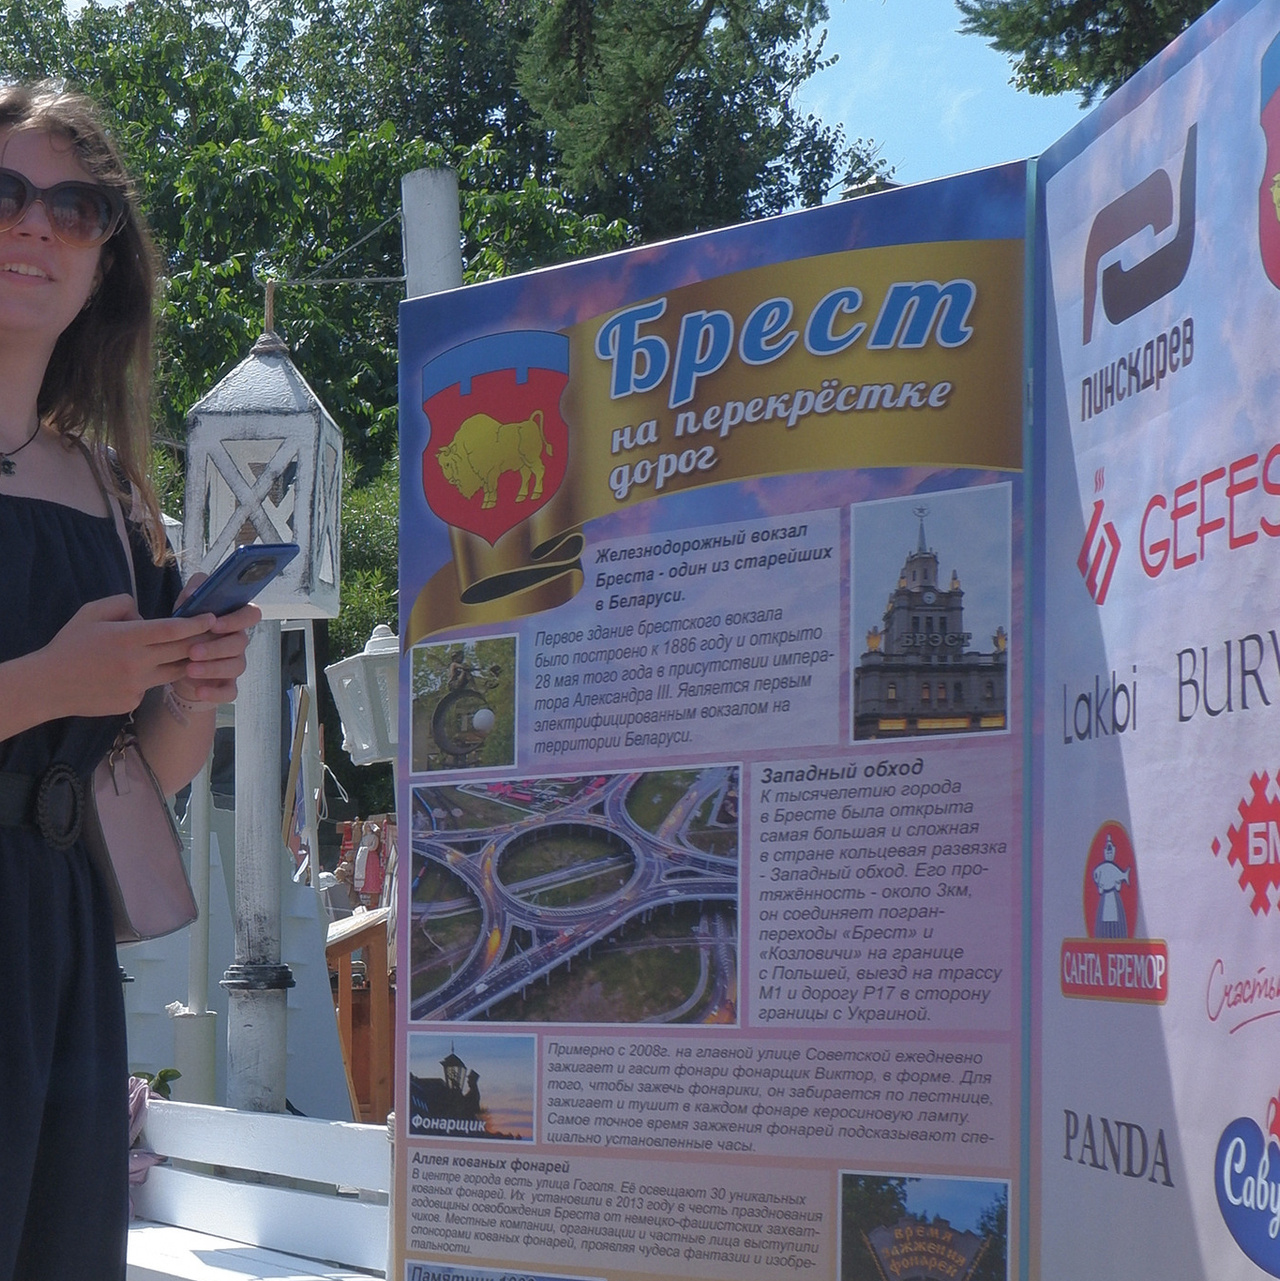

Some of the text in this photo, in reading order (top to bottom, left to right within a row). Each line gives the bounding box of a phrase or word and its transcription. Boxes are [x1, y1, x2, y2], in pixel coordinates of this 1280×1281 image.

[594, 277, 977, 409] Брест
[611, 376, 953, 455] на перекрёстке
[608, 442, 719, 500] дорог
[594, 524, 808, 565] Железнодорожный вокзал
[595, 569, 655, 591] Бреста
[668, 561, 708, 579] один
[711, 559, 730, 573] из
[733, 546, 834, 571] старейших
[595, 599, 605, 612] в
[534, 607, 783, 649] Первое здание брестского вокзала
[900, 632, 972, 648] БРЭСТ
[534, 626, 823, 669] было построено к 1886 году и открыто
[534, 673, 552, 690] 28
[553, 673, 580, 688] мая
[582, 670, 619, 685] того
[620, 663, 654, 682] года
[656, 665, 666, 678] в
[668, 655, 770, 680] присутствии
[533, 696, 570, 714] тора
[572, 686, 654, 708] Александра
[676, 679, 751, 699] Является
[753, 674, 813, 694] первым
[1063, 664, 1138, 745] Lakbi
[533, 699, 791, 733] электрифицированным вокзалом на
[533, 735, 622, 757] территории
[760, 758, 924, 784] Западный обход
[774, 785, 897, 803] тысячелетию
[900, 778, 962, 799] города
[773, 807, 837, 827] Бресте
[841, 804, 885, 820] была
[889, 801, 974, 820] открыта
[759, 829, 810, 843] самая
[812, 825, 887, 841] большая
[905, 822, 980, 837] сложная
[772, 848, 835, 865] стране
[838, 845, 928, 861] кольцевая
[930, 842, 1008, 860] развязка
[769, 865, 852, 882] Западный
[914, 862, 947, 878] Его
[758, 886, 866, 902] тяжённость
[881, 886, 932, 899] около
[758, 910, 779, 922] он
[782, 905, 874, 921] соединяет
[758, 925, 838, 945] переходы
[867, 948, 888, 960] на
[891, 947, 965, 963] границе
[856, 964, 908, 981] выезд
[911, 968, 933, 980] на
[937, 967, 1003, 984] трассу
[1063, 951, 1166, 990] САНТА БРЕМОР
[801, 986, 858, 1004] дорогу
[914, 988, 992, 1005] сторону
[1206, 958, 1280, 1022] Счасть
[757, 1008, 829, 1023] границы
[547, 1042, 616, 1059] Примерно
[675, 1047, 693, 1058] на
[695, 1046, 754, 1060] главной
[756, 1049, 802, 1063] улице
[805, 1047, 891, 1063] Советской
[894, 1049, 983, 1065] ежедневно
[547, 1062, 614, 1074] зажигает
[627, 1064, 671, 1076] гасит
[673, 1062, 730, 1080] фонари
[732, 1064, 811, 1082] фонарщик
[958, 1069, 993, 1086] Для
[588, 1079, 635, 1093] чтобы
[636, 1082, 685, 1094] зажечь
[767, 1086, 786, 1098] он
[788, 1085, 882, 1102] забирается
[884, 1090, 905, 1102] по
[411, 1114, 487, 1134] Фонарщик
[1062, 1109, 1176, 1188] PANDA
[411, 1151, 570, 1176] Аллея кованых фонарей
